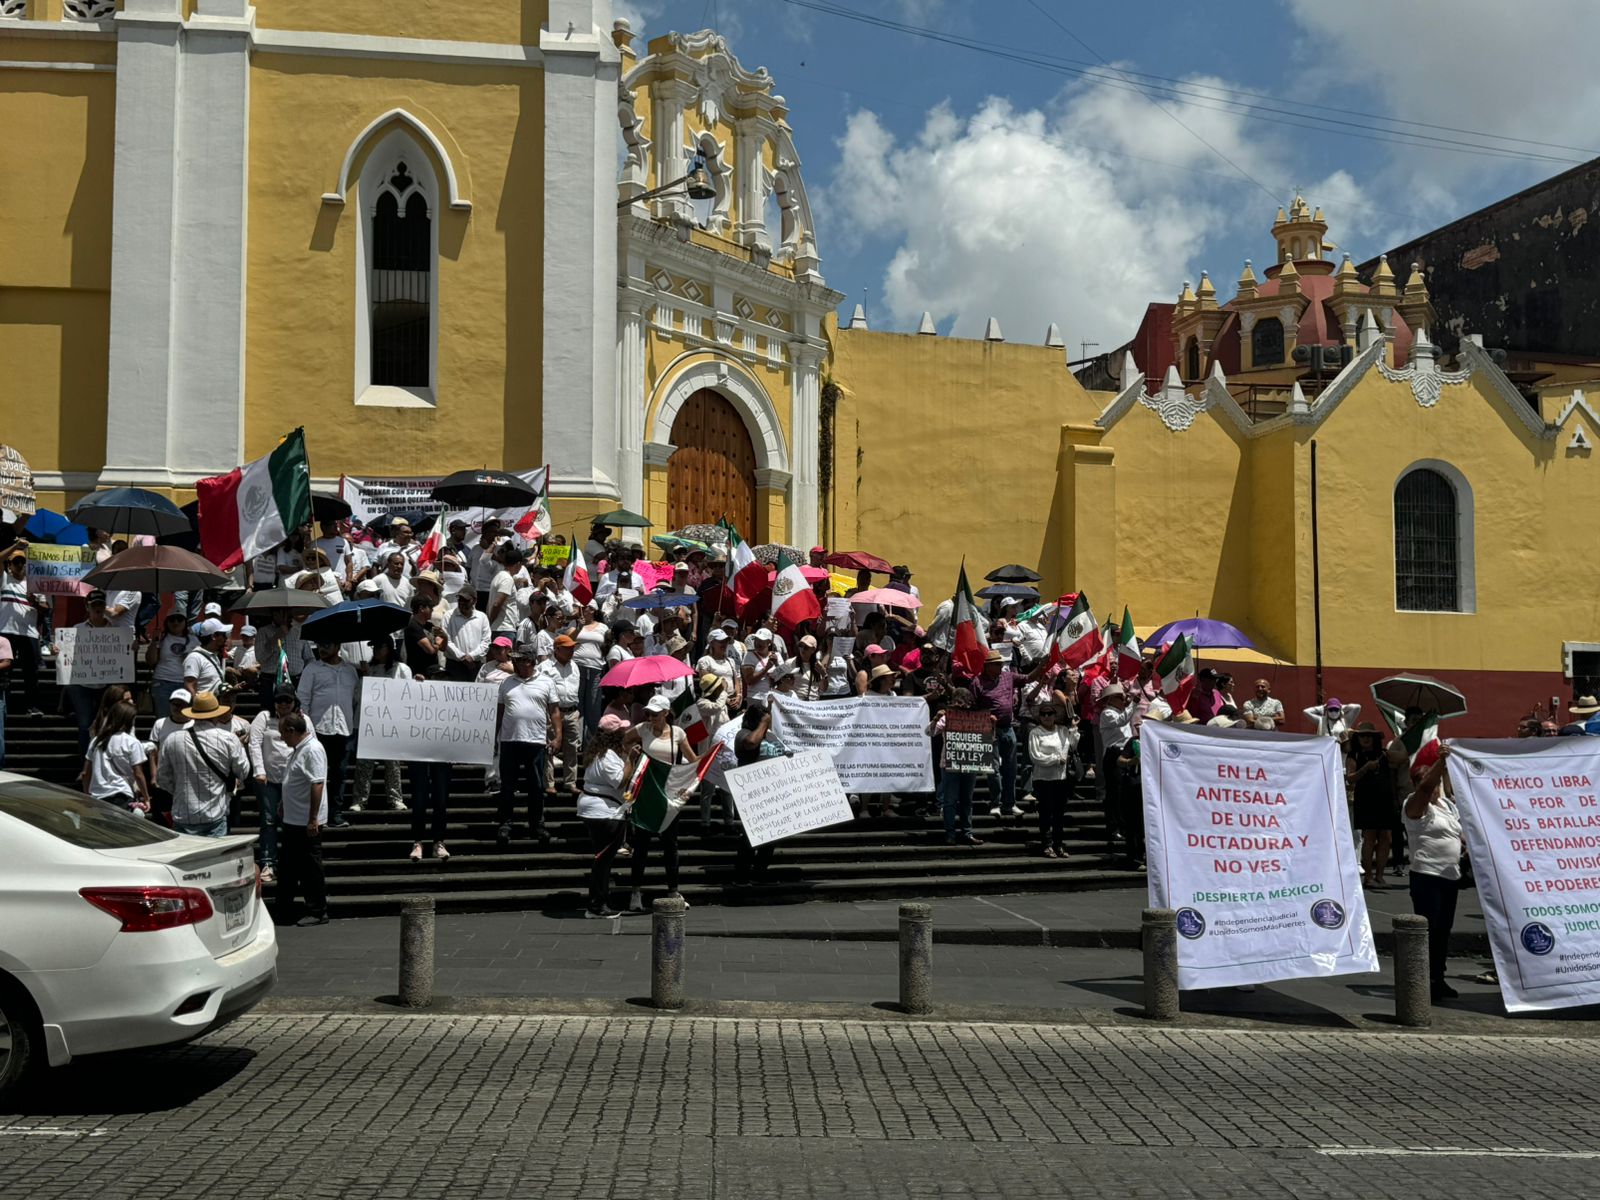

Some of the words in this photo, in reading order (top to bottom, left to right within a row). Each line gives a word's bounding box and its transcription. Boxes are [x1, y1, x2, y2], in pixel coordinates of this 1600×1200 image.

[406, 487, 415, 495] SU
[418, 480, 440, 488] EXTRA
[367, 505, 376, 513] UN
[27, 547, 60, 561] ESTAMOS
[63, 550, 74, 562] EN
[46, 565, 58, 577] NO
[60, 564, 81, 577] SER
[401, 682, 412, 701] A
[419, 684, 439, 702] LA
[443, 685, 498, 702] INDEPEN-
[364, 705, 392, 720] CIA
[402, 704, 471, 722] JUDICIAL
[479, 707, 496, 721] NO
[364, 723, 375, 737] A
[381, 724, 399, 738] LA
[409, 725, 490, 743] DICTADURA
[946, 732, 983, 742] REQUIERE
[945, 741, 993, 752] CONOCIMIENTO
[946, 751, 956, 760] DE
[956, 752, 966, 761] LA
[968, 752, 984, 761] LEY
[733, 764, 780, 790] QUEREMOS
[782, 756, 810, 773] JUECES
[812, 753, 823, 763] DE
[1217, 764, 1240, 779] EN
[1246, 767, 1268, 781] LA
[1491, 774, 1544, 790] MÉXICO
[1551, 775, 1591, 788] LIBRA
[740, 785, 771, 802] CARRERA
[742, 807, 748, 816] Y
[804, 781, 825, 792] JUECES
[1195, 786, 1287, 806] ANTESALA
[1499, 798, 1516, 810] LA
[1529, 796, 1566, 809] PEOR
[1579, 795, 1597, 807] DE
[804, 808, 812, 816] LA
[1211, 811, 1233, 826] DE
[1239, 813, 1280, 828] UNA
[1505, 818, 1530, 831] SUS
[1536, 815, 1600, 829] BATALLAS
[769, 829, 789, 838] LOS
[1187, 833, 1294, 850] DICTADURA
[1297, 835, 1310, 848] Y
[1214, 859, 1243, 874] NO
[1248, 859, 1287, 873] VES.
[1517, 860, 1536, 872] LA
[1524, 880, 1543, 893] DE
[1544, 878, 1600, 892] PODERE
[1192, 891, 1265, 904] ¡DESPIERTA
[1269, 883, 1324, 900] MÉXICO!
[1523, 905, 1563, 918] TODOS
[1564, 903, 1600, 915] SOMO
[1208, 920, 1306, 937] #UnidosSomosMásFuertes
[1563, 919, 1600, 935] JUDICI
[1559, 952, 1600, 962] #Independ
